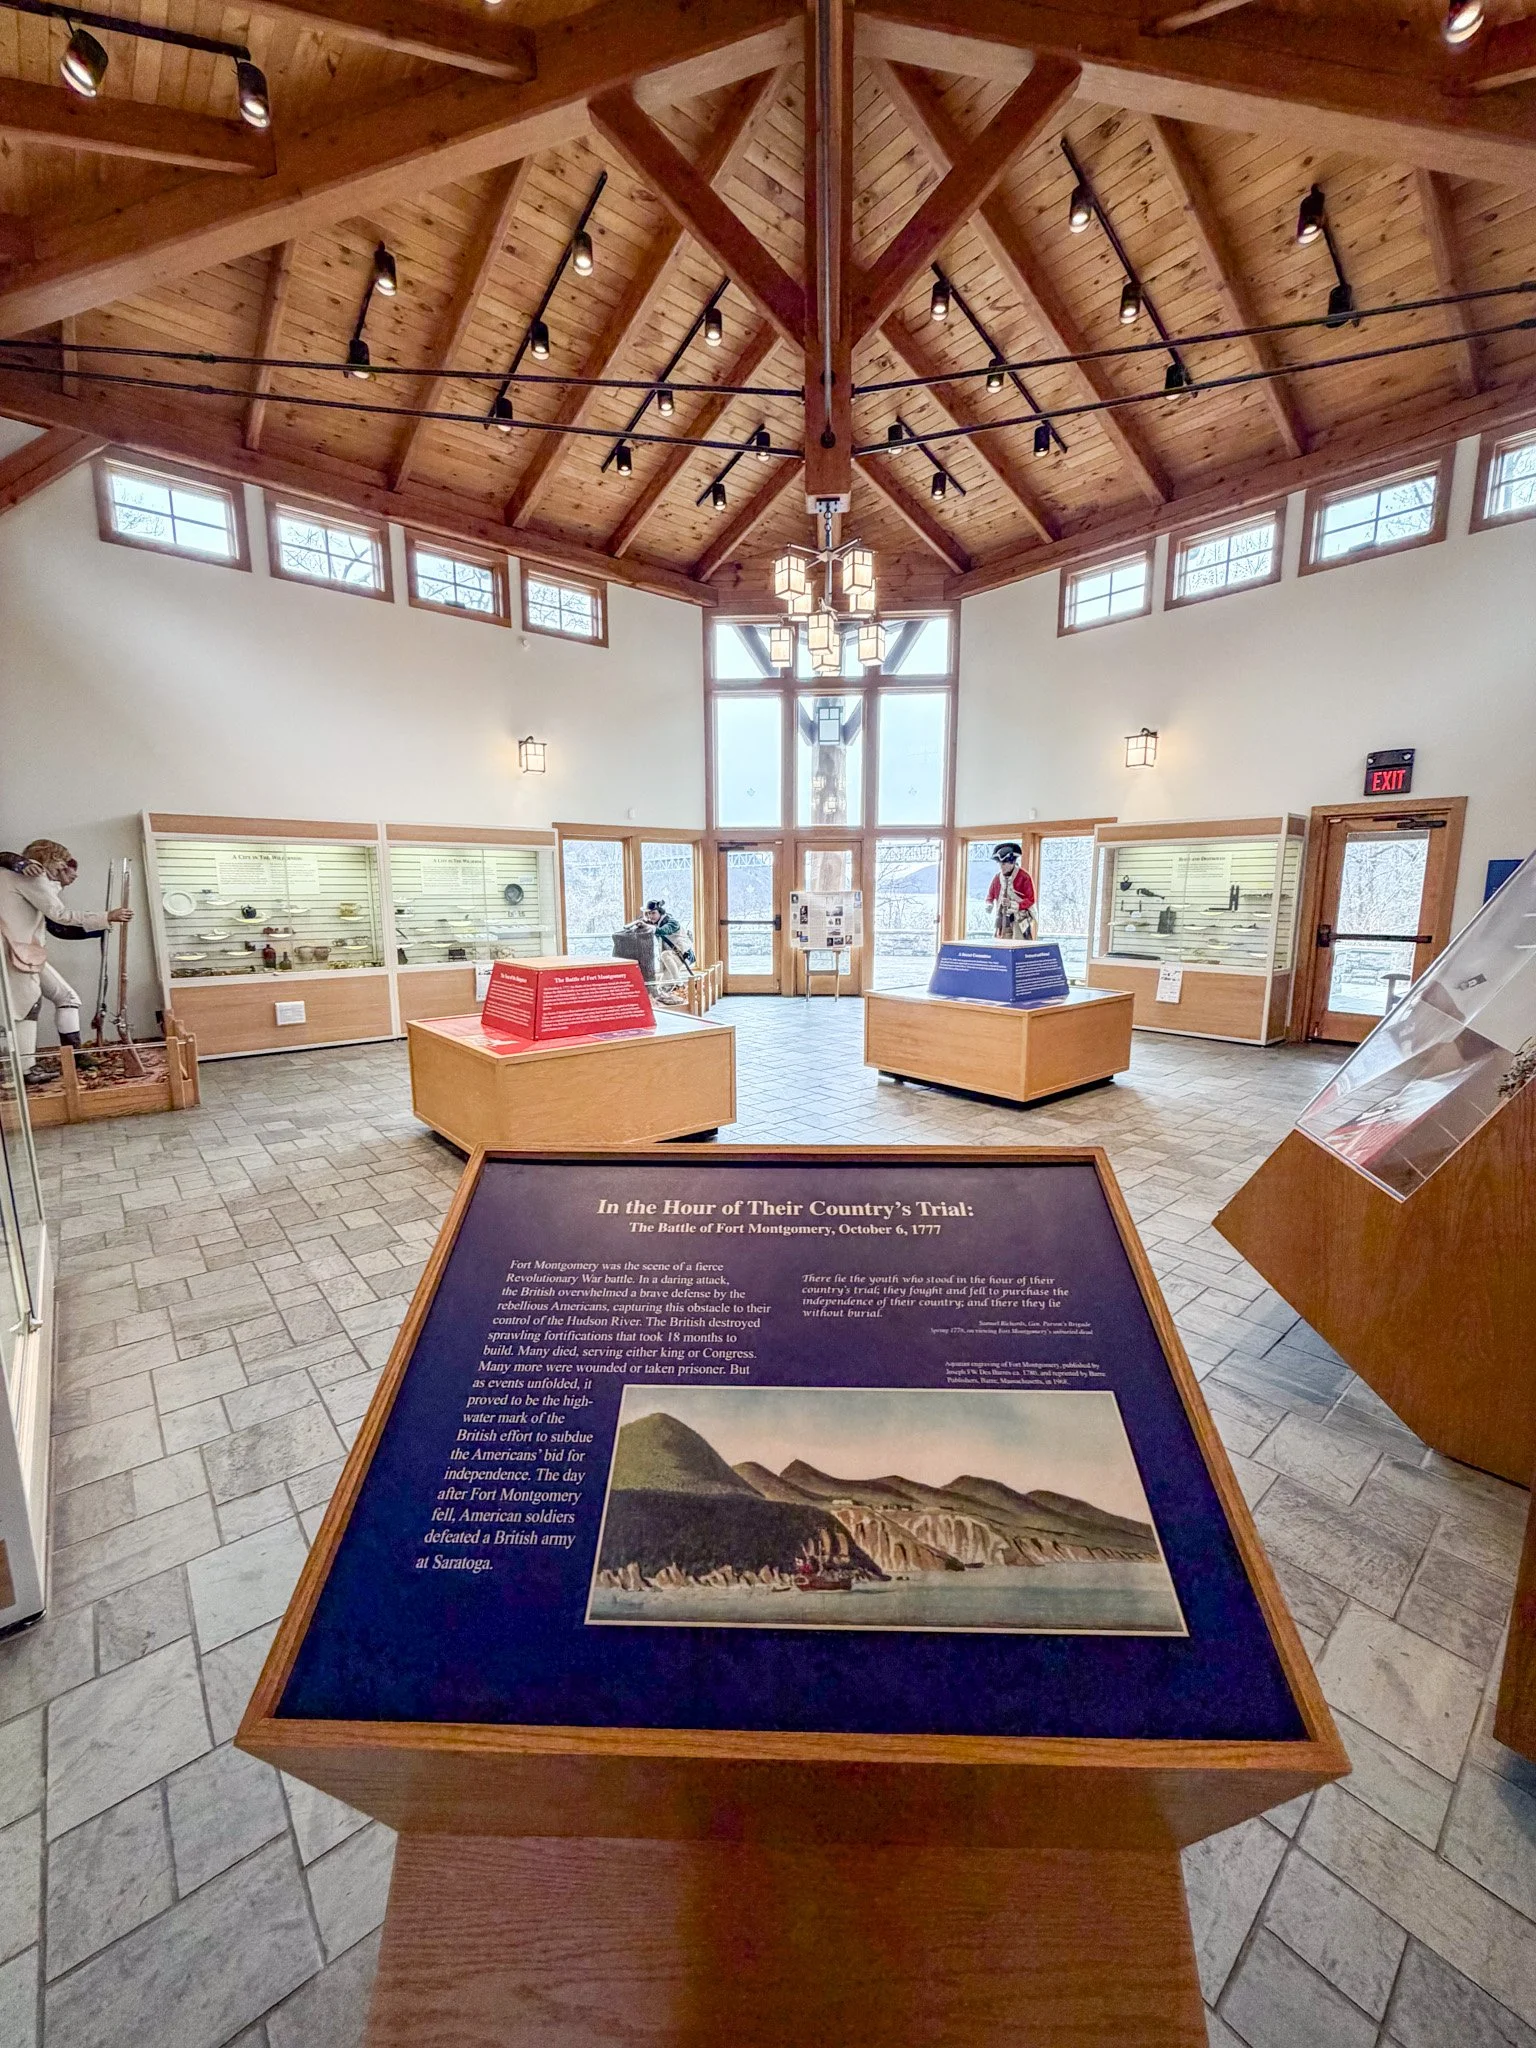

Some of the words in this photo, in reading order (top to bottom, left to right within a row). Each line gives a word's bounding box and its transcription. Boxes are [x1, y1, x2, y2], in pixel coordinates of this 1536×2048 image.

[1372, 770, 1406, 791] EXIT
[596, 1199, 618, 1214] In
[625, 1199, 656, 1214] the
[662, 1199, 716, 1214] Hour
[721, 1200, 743, 1215] of
[747, 1200, 803, 1215] Their
[809, 1200, 911, 1219] Country's
[915, 1201, 973, 1216] Trial:
[629, 1222, 654, 1232] The
[657, 1222, 696, 1233] Battle
[699, 1223, 714, 1233] of
[716, 1222, 744, 1233] Fort
[748, 1223, 835, 1236] Montgomery,
[838, 1223, 892, 1234] October
[895, 1224, 908, 1235] 6,
[911, 1224, 941, 1234] 1777
[509, 1259, 531, 1269] Fort
[533, 1260, 599, 1272] Montgomery
[623, 1261, 640, 1270] the
[672, 1261, 685, 1270] of
[695, 1261, 723, 1271] fierce
[505, 1273, 579, 1285] Revolutionary
[582, 1273, 603, 1283] War
[604, 1273, 635, 1283] battle.
[638, 1274, 649, 1283] In
[660, 1274, 693, 1286] daring
[695, 1275, 729, 1285] attack,
[801, 1273, 831, 1282] There
[834, 1273, 846, 1282] lie
[849, 1273, 866, 1282] the
[868, 1274, 898, 1285] youth
[902, 1274, 923, 1283] who
[926, 1274, 954, 1283] stood
[970, 1274, 985, 1284] the
[989, 1275, 1014, 1284] hour
[1016, 1275, 1027, 1287] of
[1029, 1275, 1055, 1284] their
[501, 1286, 518, 1296] the
[520, 1286, 555, 1296] British
[557, 1287, 628, 1297] overwhelmed
[639, 1288, 668, 1297] brave
[670, 1288, 711, 1298] defense
[713, 1288, 726, 1301] by
[729, 1289, 745, 1298] the
[801, 1285, 850, 1296] country's
[853, 1284, 880, 1294] trial;
[883, 1285, 906, 1297] they
[907, 1285, 942, 1297] fought
[945, 1286, 968, 1295] and
[967, 1286, 987, 1297] fell
[1000, 1286, 1049, 1298] purchase
[1052, 1286, 1069, 1296] the
[497, 1300, 549, 1310] rebellious
[550, 1301, 609, 1311] Americans,
[612, 1302, 662, 1314] capturing
[665, 1302, 684, 1312] this
[686, 1302, 730, 1312] obstacle
[733, 1304, 744, 1313] to
[746, 1303, 771, 1313] their
[802, 1295, 873, 1308] independence
[876, 1296, 888, 1309] of
[890, 1296, 916, 1306] their
[918, 1298, 964, 1309] country;
[966, 1297, 989, 1306] and
[991, 1296, 1018, 1307] there
[1021, 1298, 1045, 1310] they
[1048, 1298, 1061, 1307] lie
[802, 1307, 843, 1317] without
[847, 1307, 882, 1317] burial.
[492, 1315, 531, 1325] control
[532, 1315, 547, 1325] of
[547, 1315, 564, 1325] the
[566, 1315, 607, 1325] Hudson
[610, 1315, 642, 1326] River.
[645, 1316, 666, 1326] The
[669, 1316, 705, 1327] British
[708, 1317, 760, 1330] destroyed
[487, 1329, 541, 1343] sprawling
[543, 1329, 613, 1341] fortifications
[616, 1331, 636, 1341] that
[639, 1331, 663, 1341] took
[668, 1331, 680, 1341] 18
[683, 1332, 723, 1342] months
[726, 1334, 737, 1342] to
[482, 1344, 513, 1355] build.
[517, 1345, 550, 1358] Many
[552, 1345, 579, 1357] died,
[582, 1345, 623, 1359] serving
[625, 1346, 658, 1357] either
[660, 1346, 685, 1360] king
[702, 1347, 756, 1360] Congress.
[477, 1360, 511, 1374] Many
[513, 1363, 543, 1372] more
[546, 1364, 573, 1372] were
[576, 1361, 627, 1372] wounded
[629, 1365, 642, 1373] or
[644, 1362, 674, 1373] taken
[677, 1365, 726, 1376] prisoner.
[729, 1363, 749, 1374] But
[472, 1379, 485, 1387] as
[487, 1378, 524, 1388] events
[527, 1377, 580, 1390] unfolded,
[583, 1380, 592, 1389] it
[465, 1394, 509, 1408] proved
[510, 1395, 522, 1405] to
[525, 1394, 539, 1405] be
[542, 1394, 560, 1406] the
[562, 1394, 593, 1409] high-
[463, 1412, 496, 1423] water
[497, 1411, 528, 1423] mark
[530, 1411, 547, 1423] of
[546, 1411, 565, 1423] the
[456, 1428, 497, 1441] British
[499, 1429, 533, 1442] effort
[535, 1432, 548, 1442] to
[550, 1430, 593, 1442] subdue
[450, 1447, 470, 1460] the
[470, 1448, 542, 1461] Americans'
[543, 1448, 564, 1461] bid
[566, 1448, 585, 1461] for
[443, 1466, 531, 1483] independence.
[536, 1467, 559, 1481] The
[562, 1468, 585, 1485] day
[436, 1486, 468, 1500] after
[469, 1487, 496, 1500] Fort
[499, 1487, 582, 1505] Montgomery
[431, 1507, 455, 1523] fell,
[458, 1508, 521, 1522] American
[524, 1508, 575, 1523] soldiers
[423, 1528, 481, 1543] defeated
[481, 1533, 490, 1543] a
[493, 1530, 538, 1544] British
[541, 1534, 576, 1548] army
[415, 1556, 429, 1568] at
[431, 1554, 493, 1573] Saratoga.
